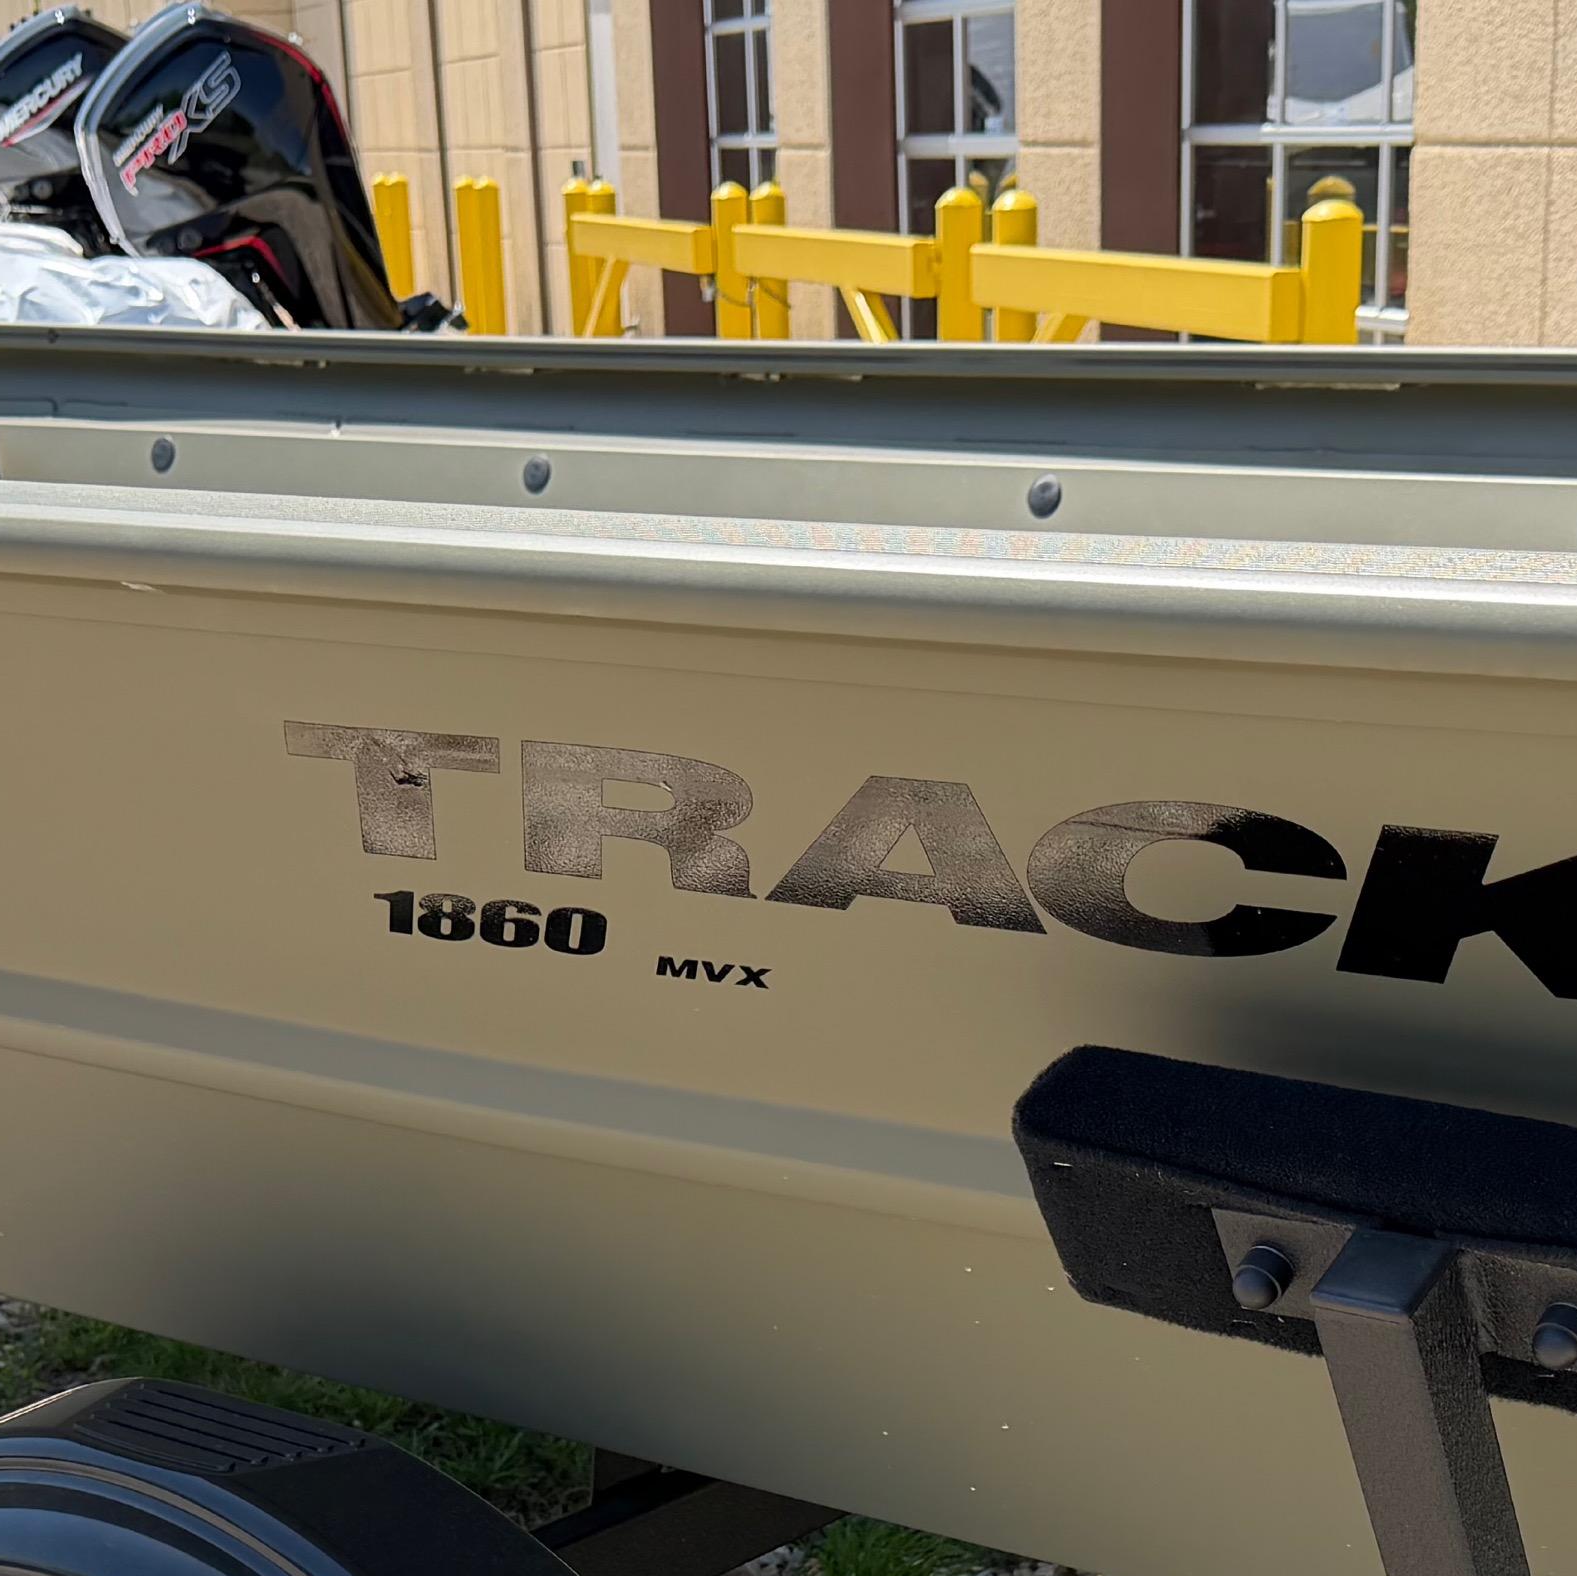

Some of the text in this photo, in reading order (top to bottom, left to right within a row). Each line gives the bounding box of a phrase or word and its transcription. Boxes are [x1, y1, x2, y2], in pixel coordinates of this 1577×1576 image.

[167, 50, 241, 165] XS
[374, 890, 608, 956] 1860
[655, 955, 771, 990] MVX
